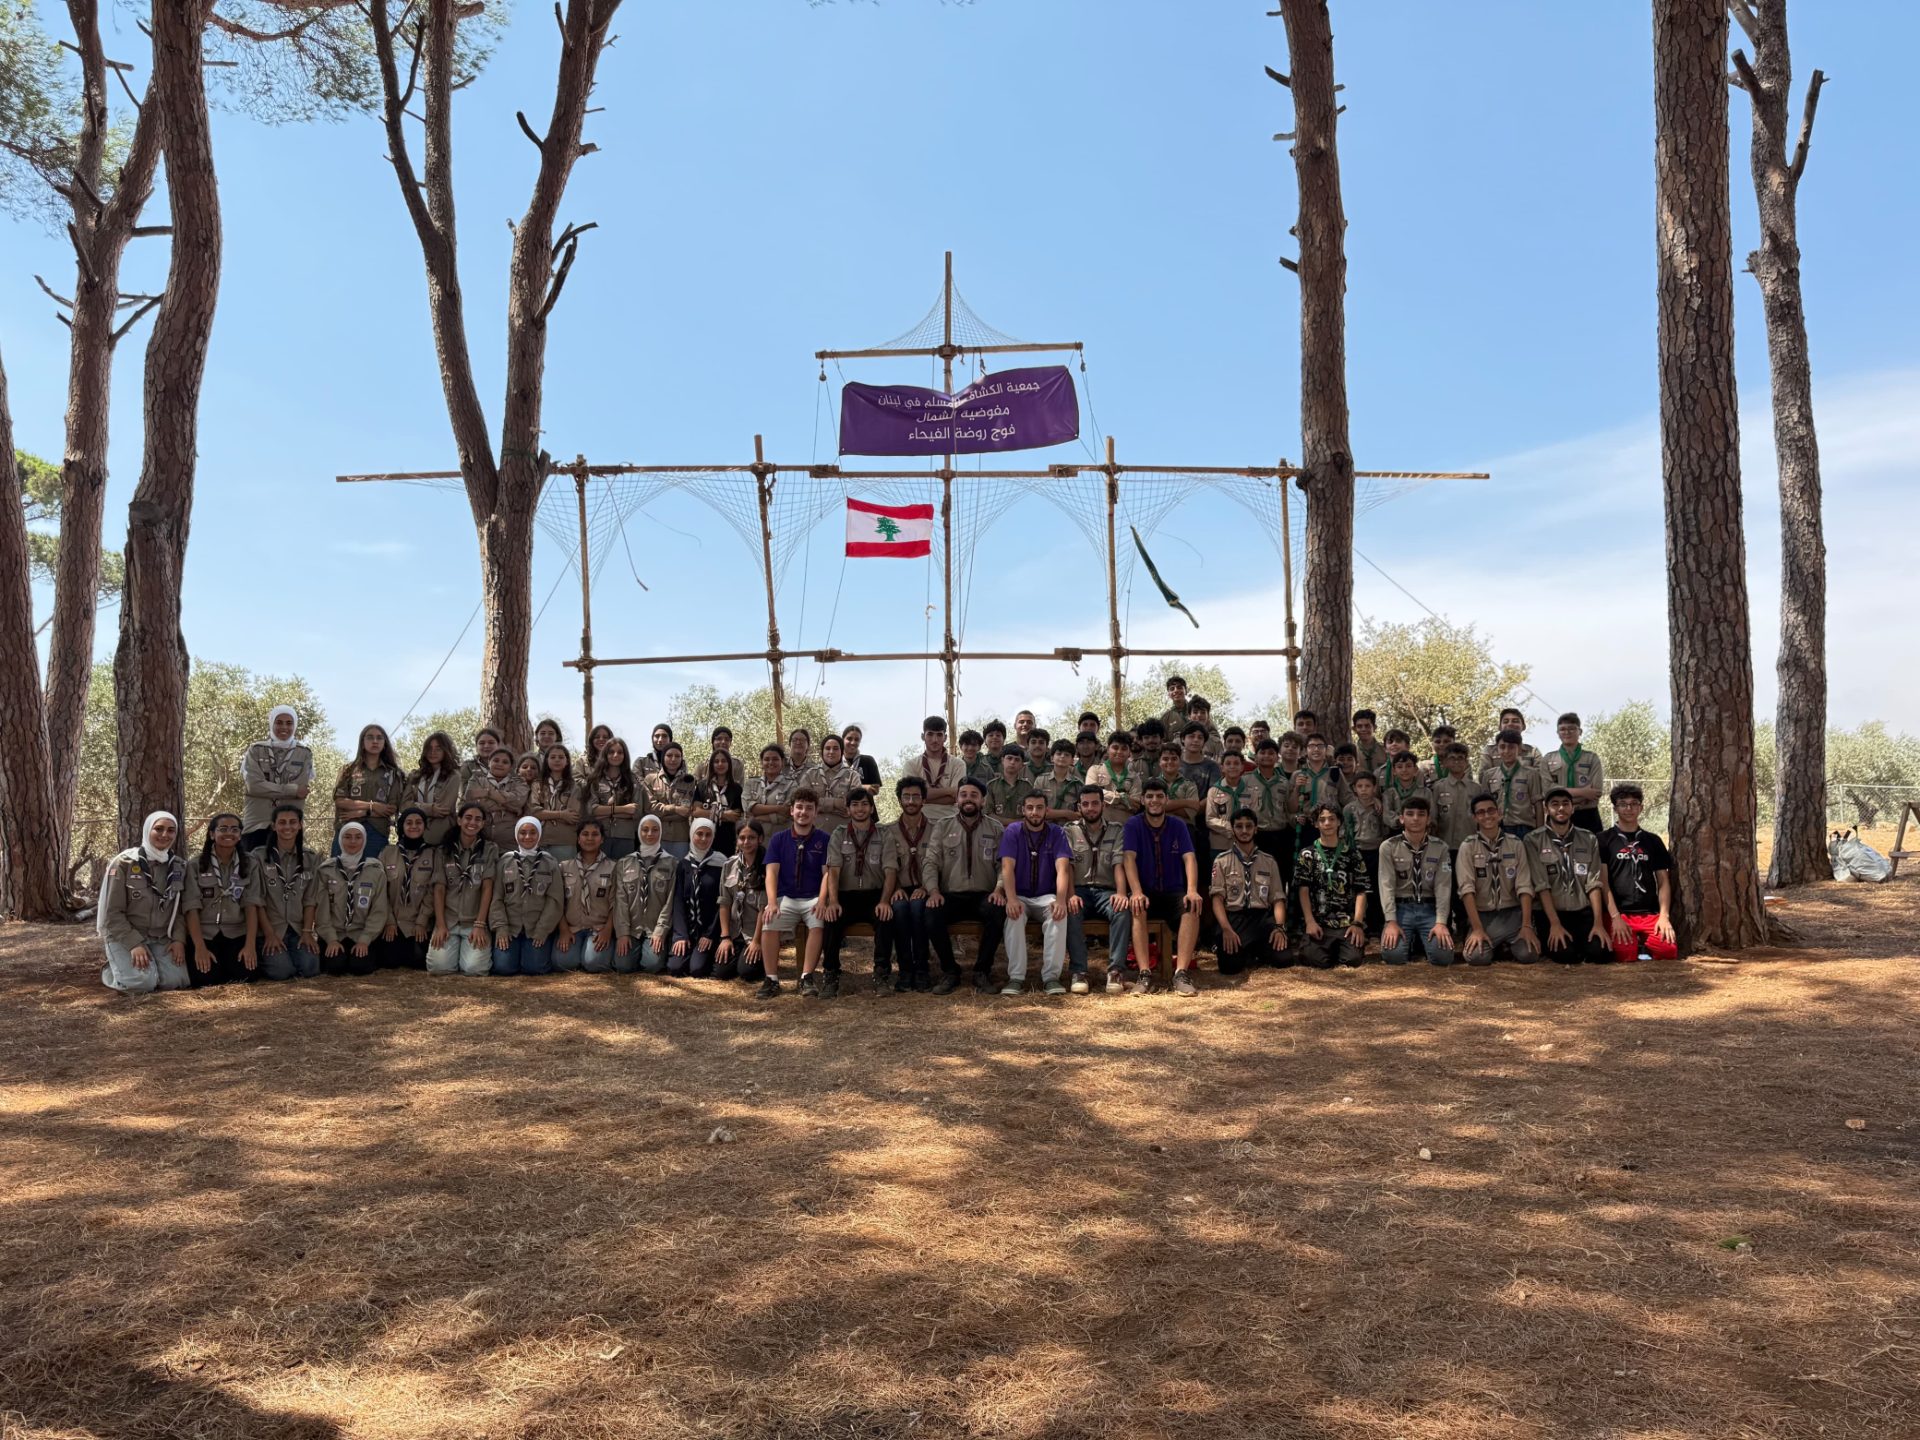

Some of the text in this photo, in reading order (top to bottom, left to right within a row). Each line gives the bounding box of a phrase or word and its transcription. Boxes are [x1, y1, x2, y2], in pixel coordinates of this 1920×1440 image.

[1006, 381, 1041, 393] جمعية
[878, 394, 901, 408] لبنان
[904, 397, 921, 410] في
[908, 423, 1016, 442] فوج روضة الفيحاء
[1616, 852, 1649, 861] adas
